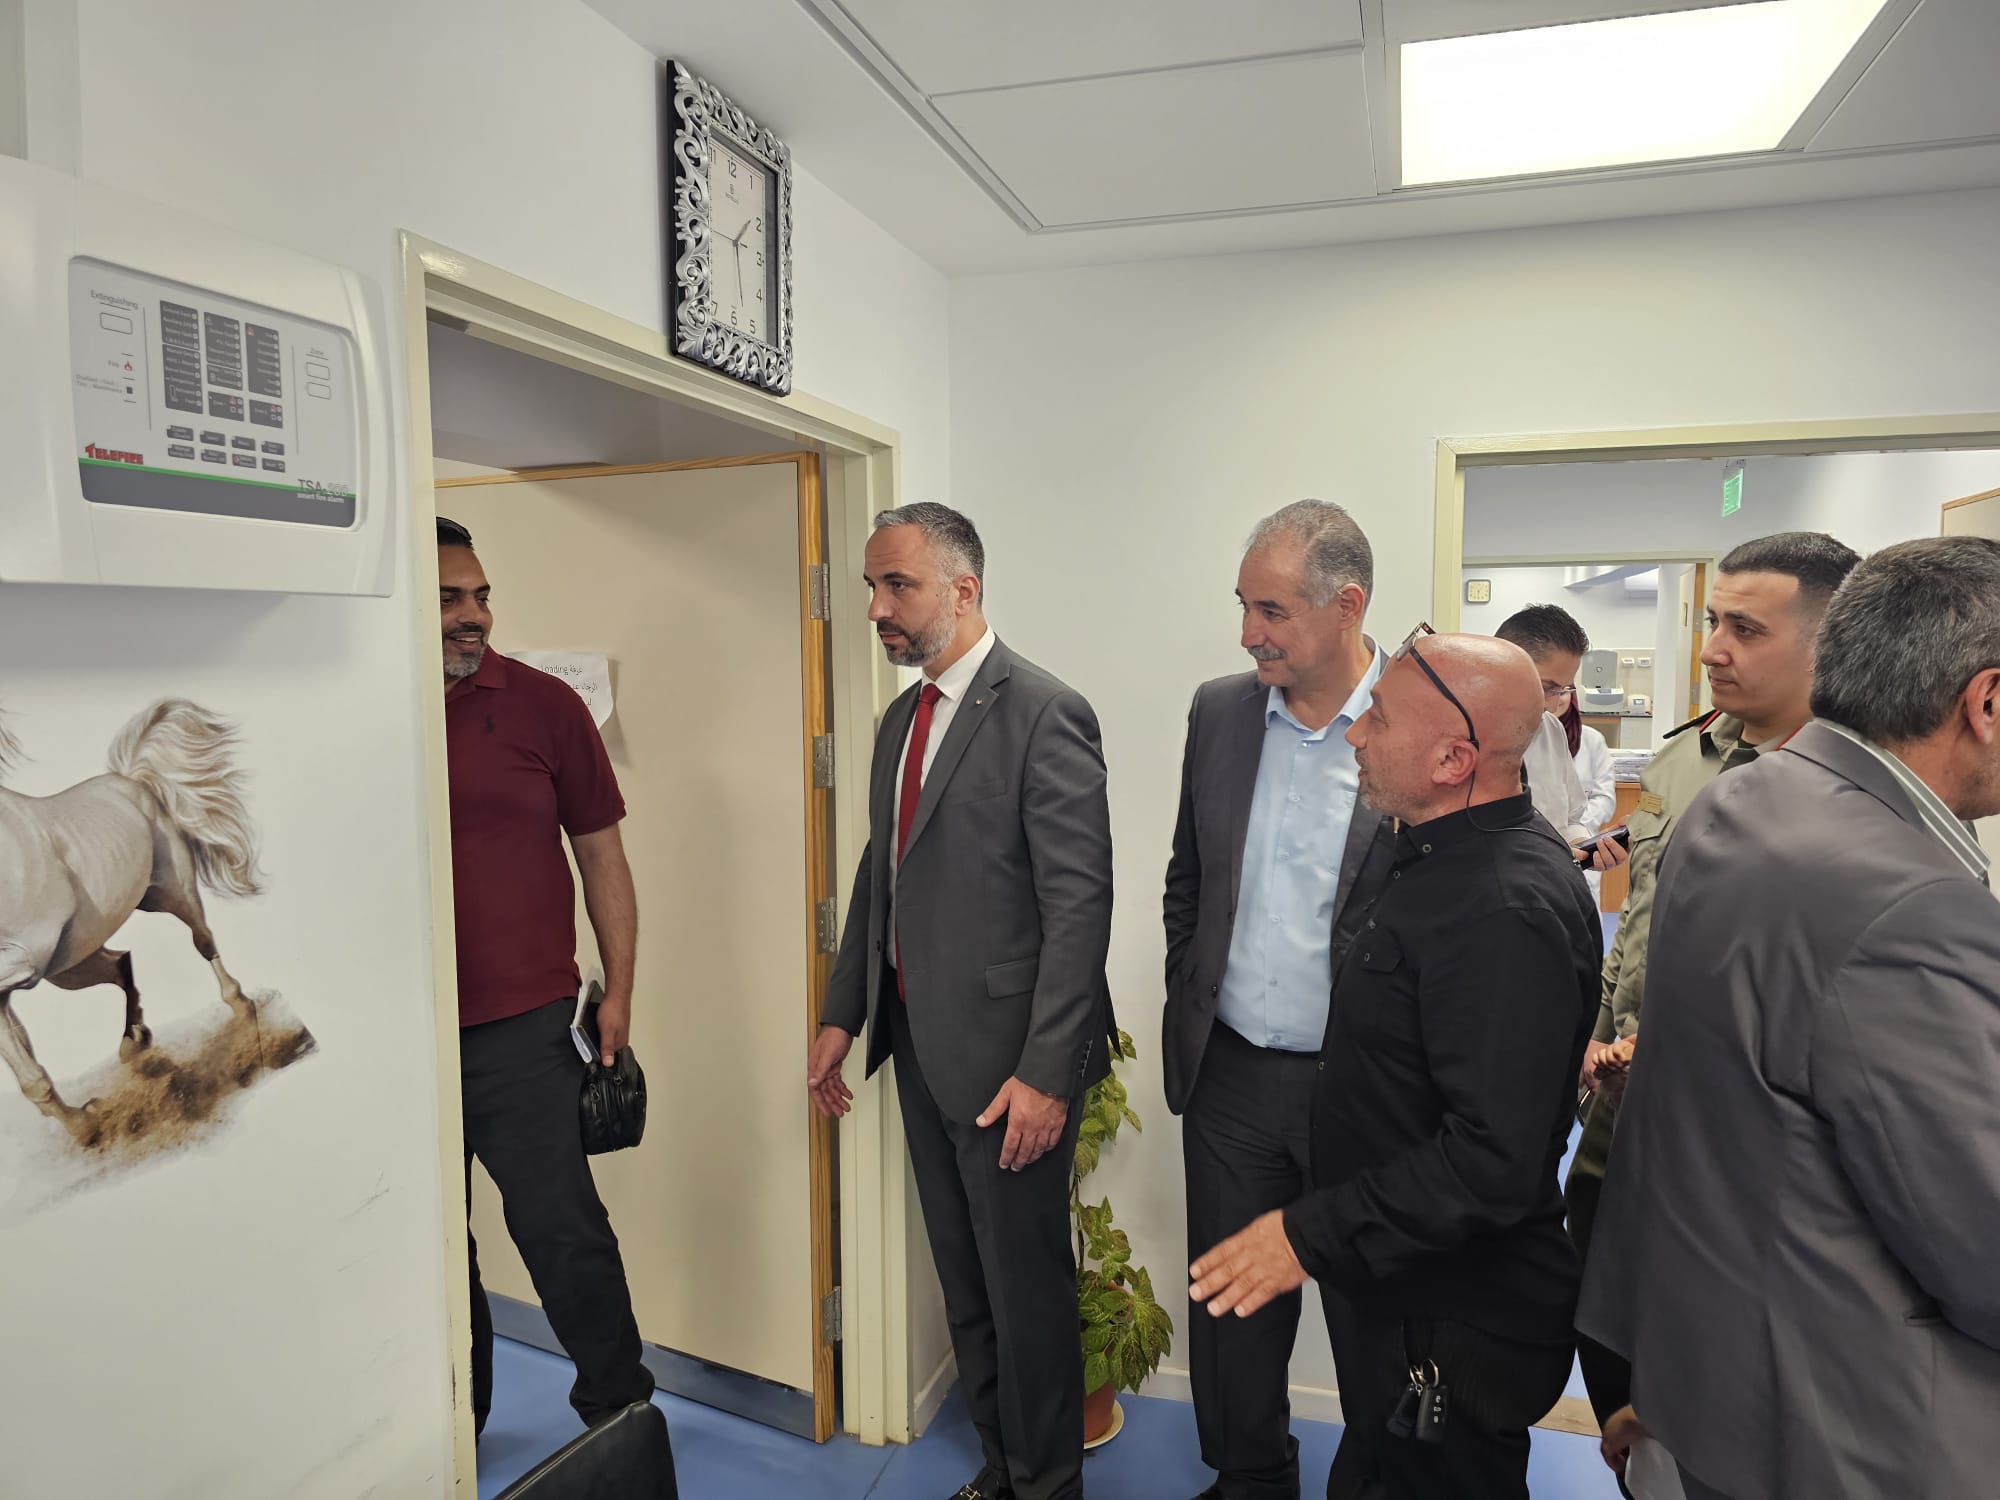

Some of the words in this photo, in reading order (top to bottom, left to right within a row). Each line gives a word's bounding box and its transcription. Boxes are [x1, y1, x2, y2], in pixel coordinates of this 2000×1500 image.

[727, 159, 737, 179] 12
[749, 174, 753, 191] 1
[756, 216, 762, 233] 2
[756, 251, 762, 267] 3
[90, 289, 139, 310] Extinguishing
[756, 288, 762, 303] 4
[731, 310, 738, 326] 6
[749, 319, 756, 334] 5
[85, 442, 144, 465] TELEFIRE
